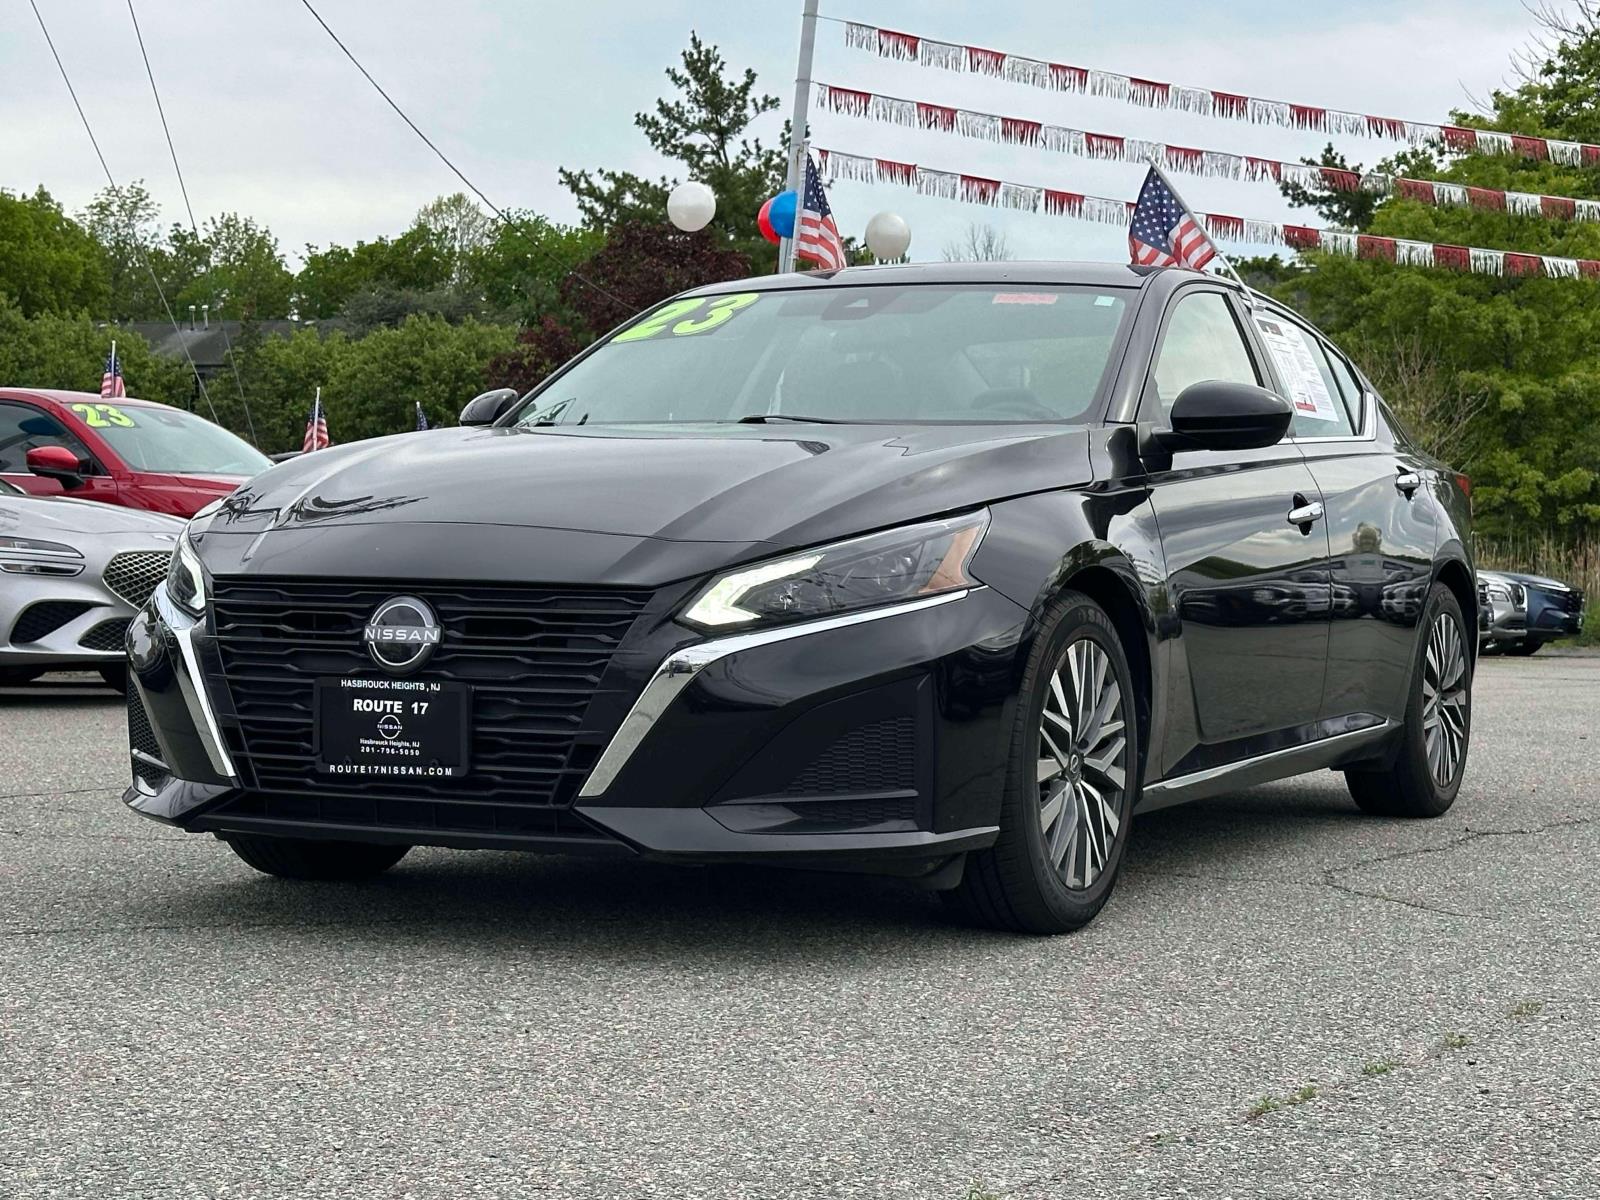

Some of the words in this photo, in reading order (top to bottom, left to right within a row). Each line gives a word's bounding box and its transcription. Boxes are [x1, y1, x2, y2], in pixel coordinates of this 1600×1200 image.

[609, 292, 760, 344] 23
[71, 404, 135, 428] 23
[365, 628, 437, 640] NISSAN
[341, 679, 390, 689] HASBROUCK
[430, 682, 441, 691] NJ
[353, 698, 403, 713] ROUTE
[411, 701, 429, 715] 17
[412, 740, 420, 748] NJ
[329, 764, 452, 776] ROUTE17NISSAN.COM
